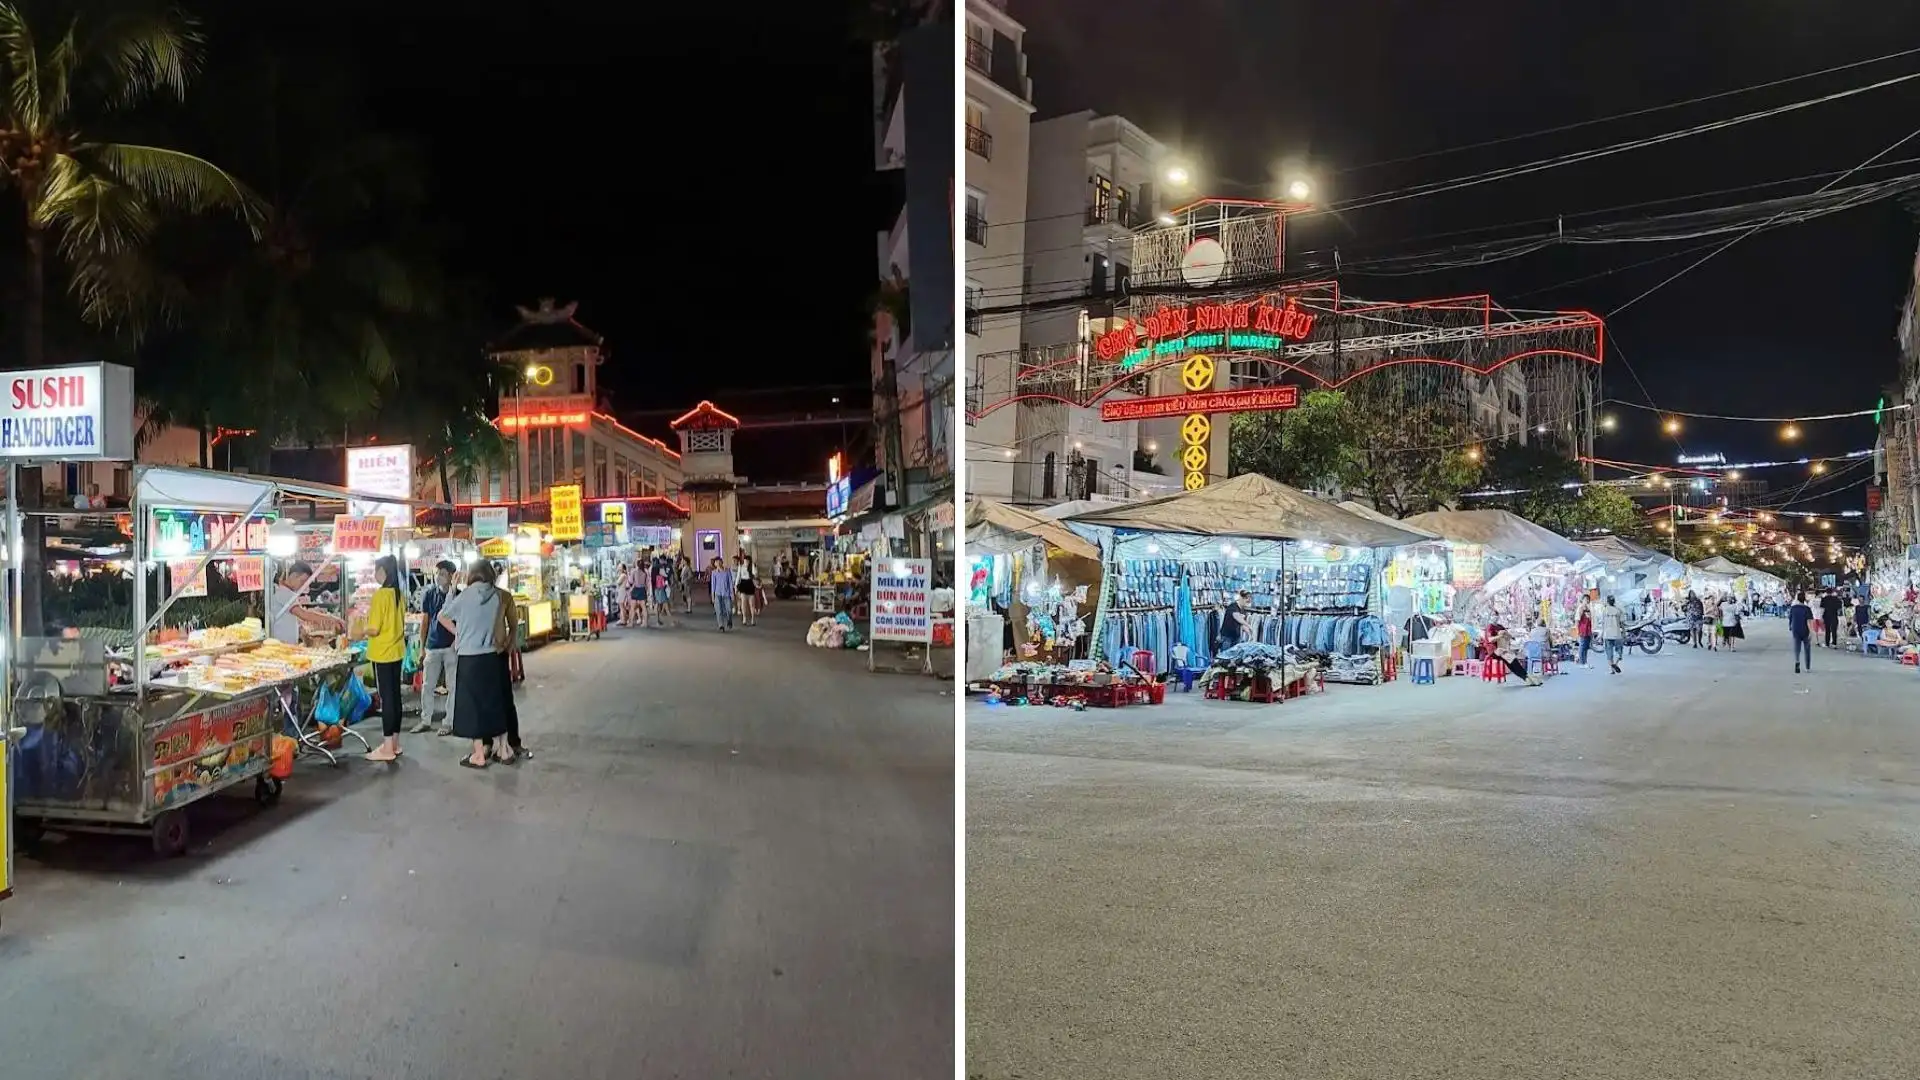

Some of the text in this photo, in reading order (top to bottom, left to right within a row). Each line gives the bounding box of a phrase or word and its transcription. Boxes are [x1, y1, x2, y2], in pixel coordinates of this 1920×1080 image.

[1097, 319, 1137, 359] CHỢ
[1145, 306, 1188, 339] ĐÊM
[1195, 303, 1249, 331] NINH
[1187, 334, 1224, 348] NIGHT
[1230, 335, 1282, 350] MARKET
[12, 376, 84, 410] SUSHI
[2, 416, 95, 449] HAMBURGER
[338, 535, 377, 549] 10K
